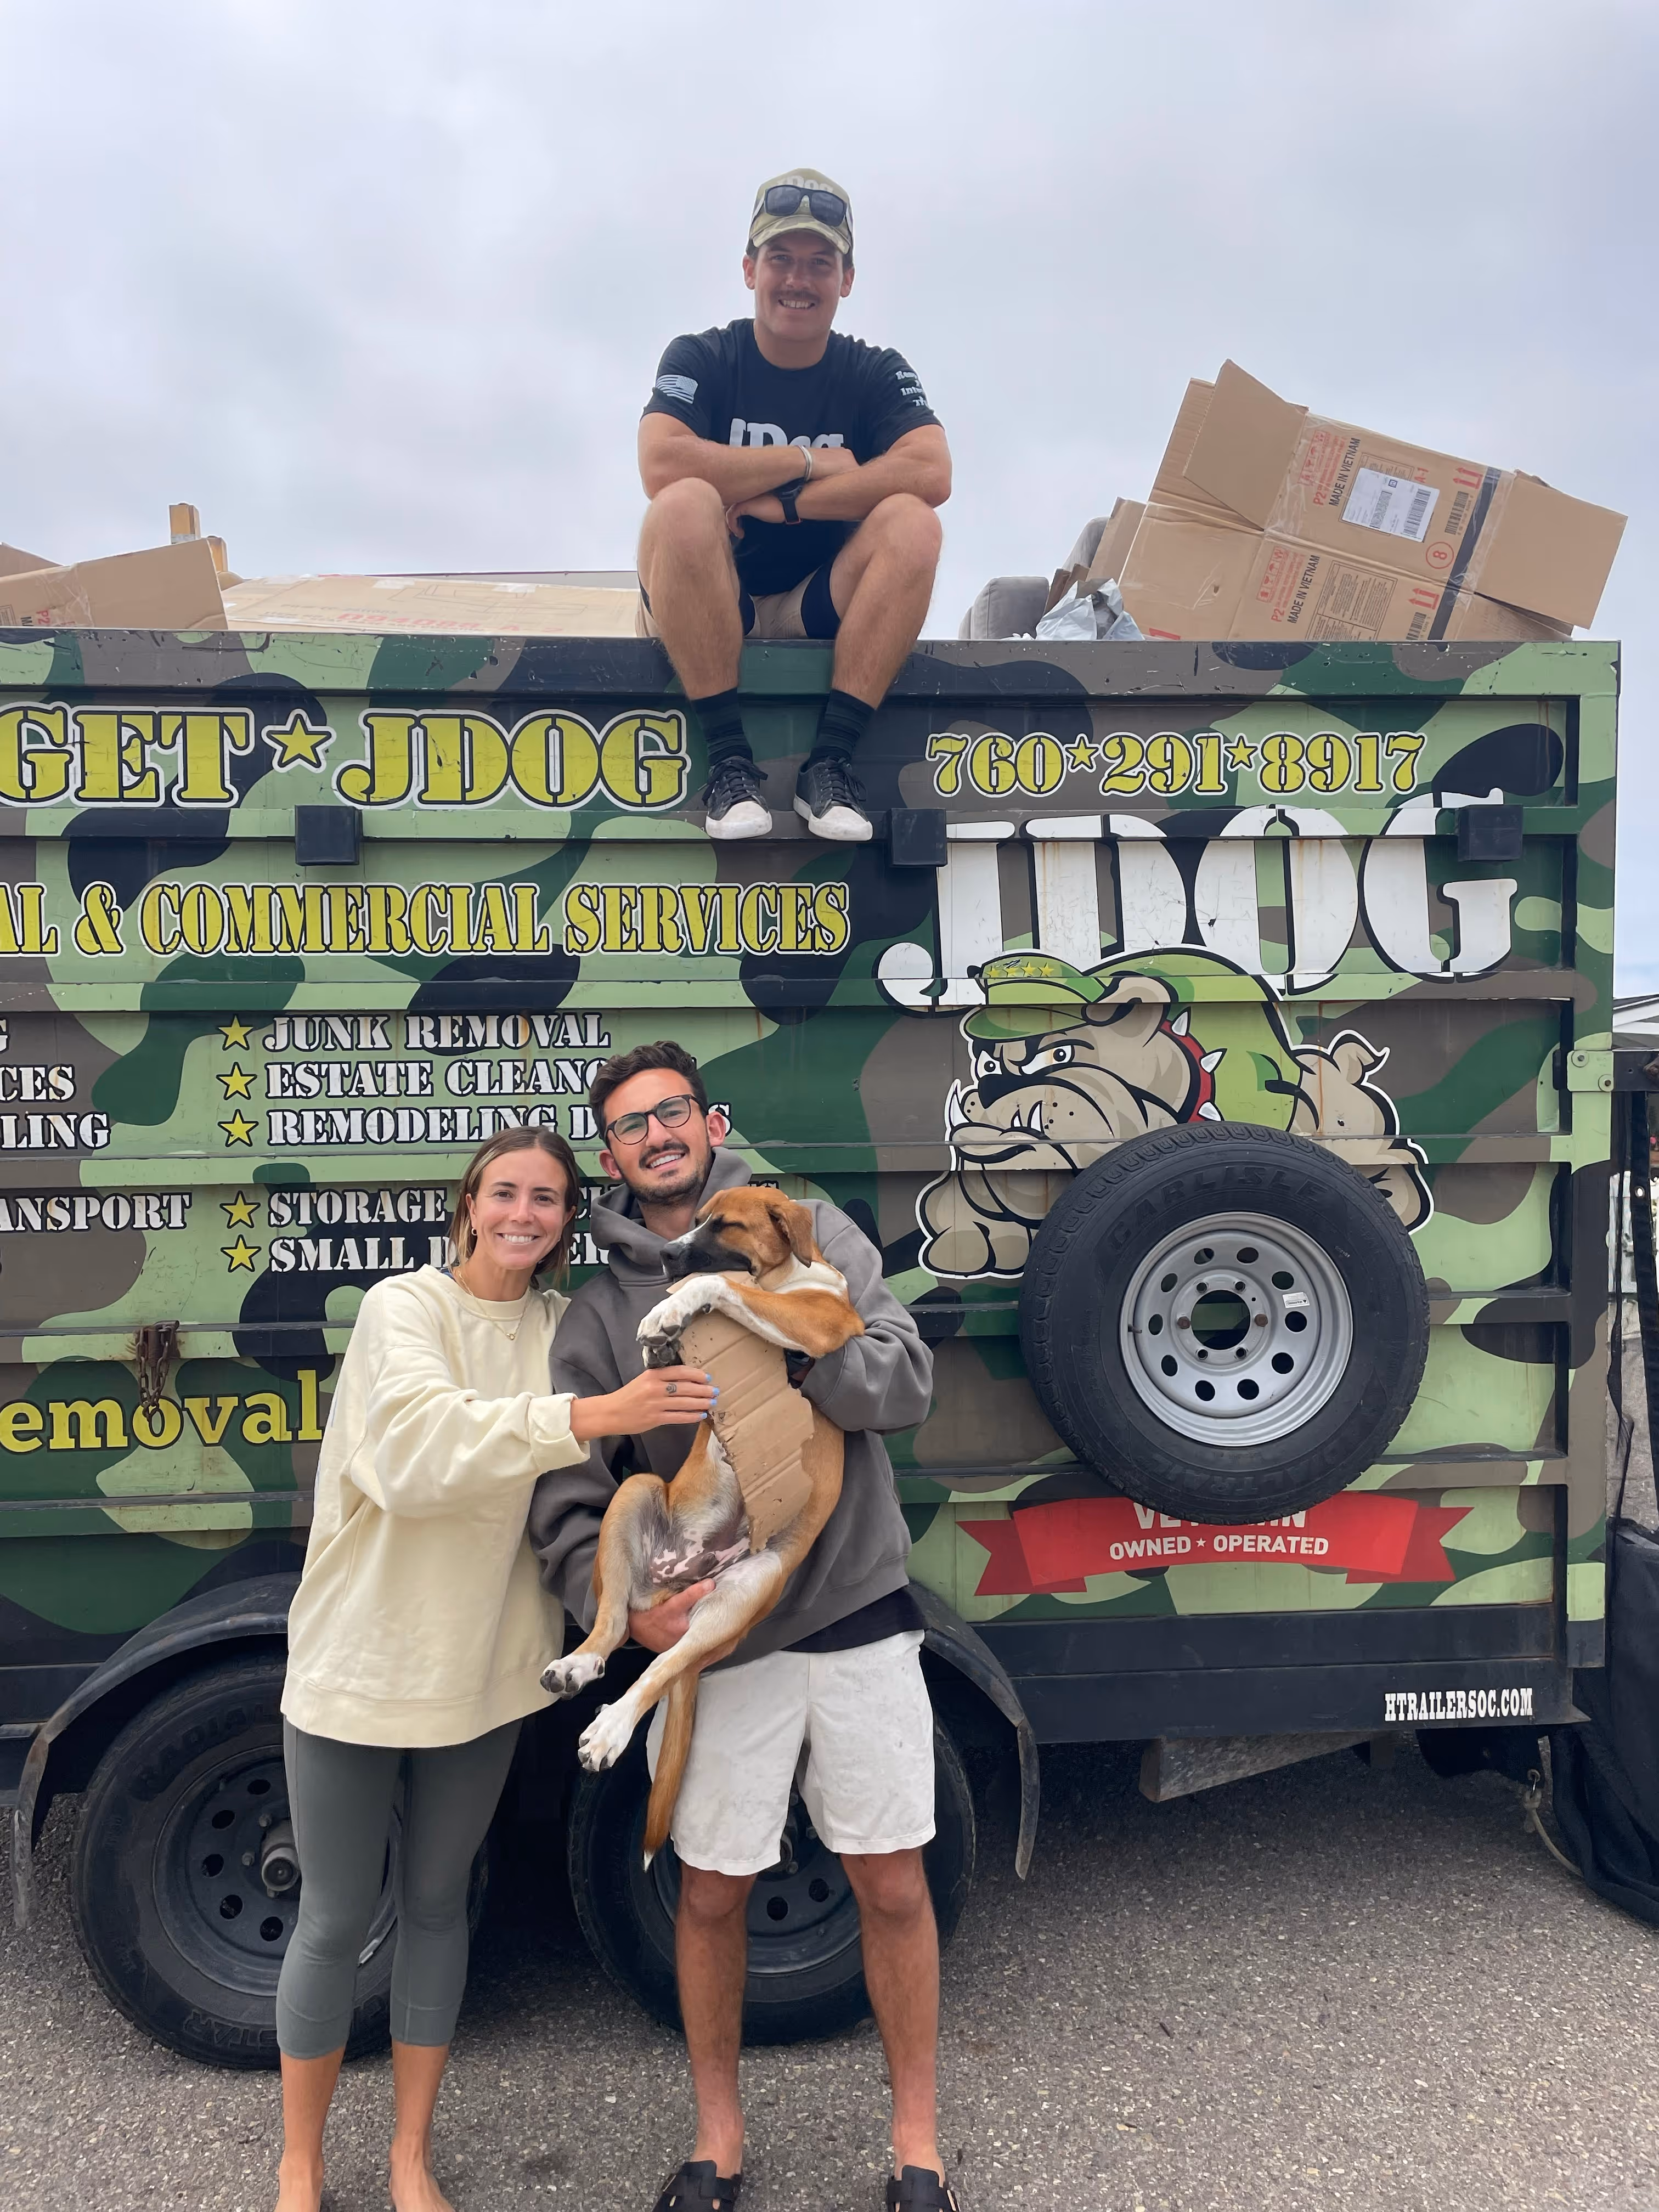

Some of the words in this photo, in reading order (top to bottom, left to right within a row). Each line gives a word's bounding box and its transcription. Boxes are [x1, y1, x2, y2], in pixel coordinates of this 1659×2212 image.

[1342, 437, 1361, 471] VIETNAM
[1329, 482, 1345, 507] MADE
[1338, 473, 1349, 483] IN
[1313, 490, 1327, 506] P2
[1302, 555, 1321, 589] VIETNAM
[1288, 600, 1304, 624] MADE
[1298, 589, 1308, 600] IN
[1271, 607, 1285, 623] P2
[0, 705, 253, 804] GET
[335, 712, 689, 809] JDOG
[928, 734, 1065, 795] 760
[1260, 732, 1426, 794] 8917
[877, 789, 1517, 1013] JDOG
[74, 883, 124, 956] &
[140, 883, 551, 956] COMMERCIAL
[565, 883, 850, 956] SERVICES
[264, 1016, 391, 1051] JUNK
[405, 1013, 610, 1049] REMOVAL
[266, 1061, 433, 1098] ESTATE
[0, 1113, 110, 1148] LING
[267, 1105, 557, 1144] REMODELING
[269, 1188, 446, 1226] STORAGE
[270, 1237, 414, 1272] SMALL
[0, 1370, 322, 1452] emoval
[1110, 1536, 1191, 1560] OWNED
[1214, 1534, 1329, 1555] OPERATED
[1385, 1688, 1533, 1722] HTRAILERSOC.COM
